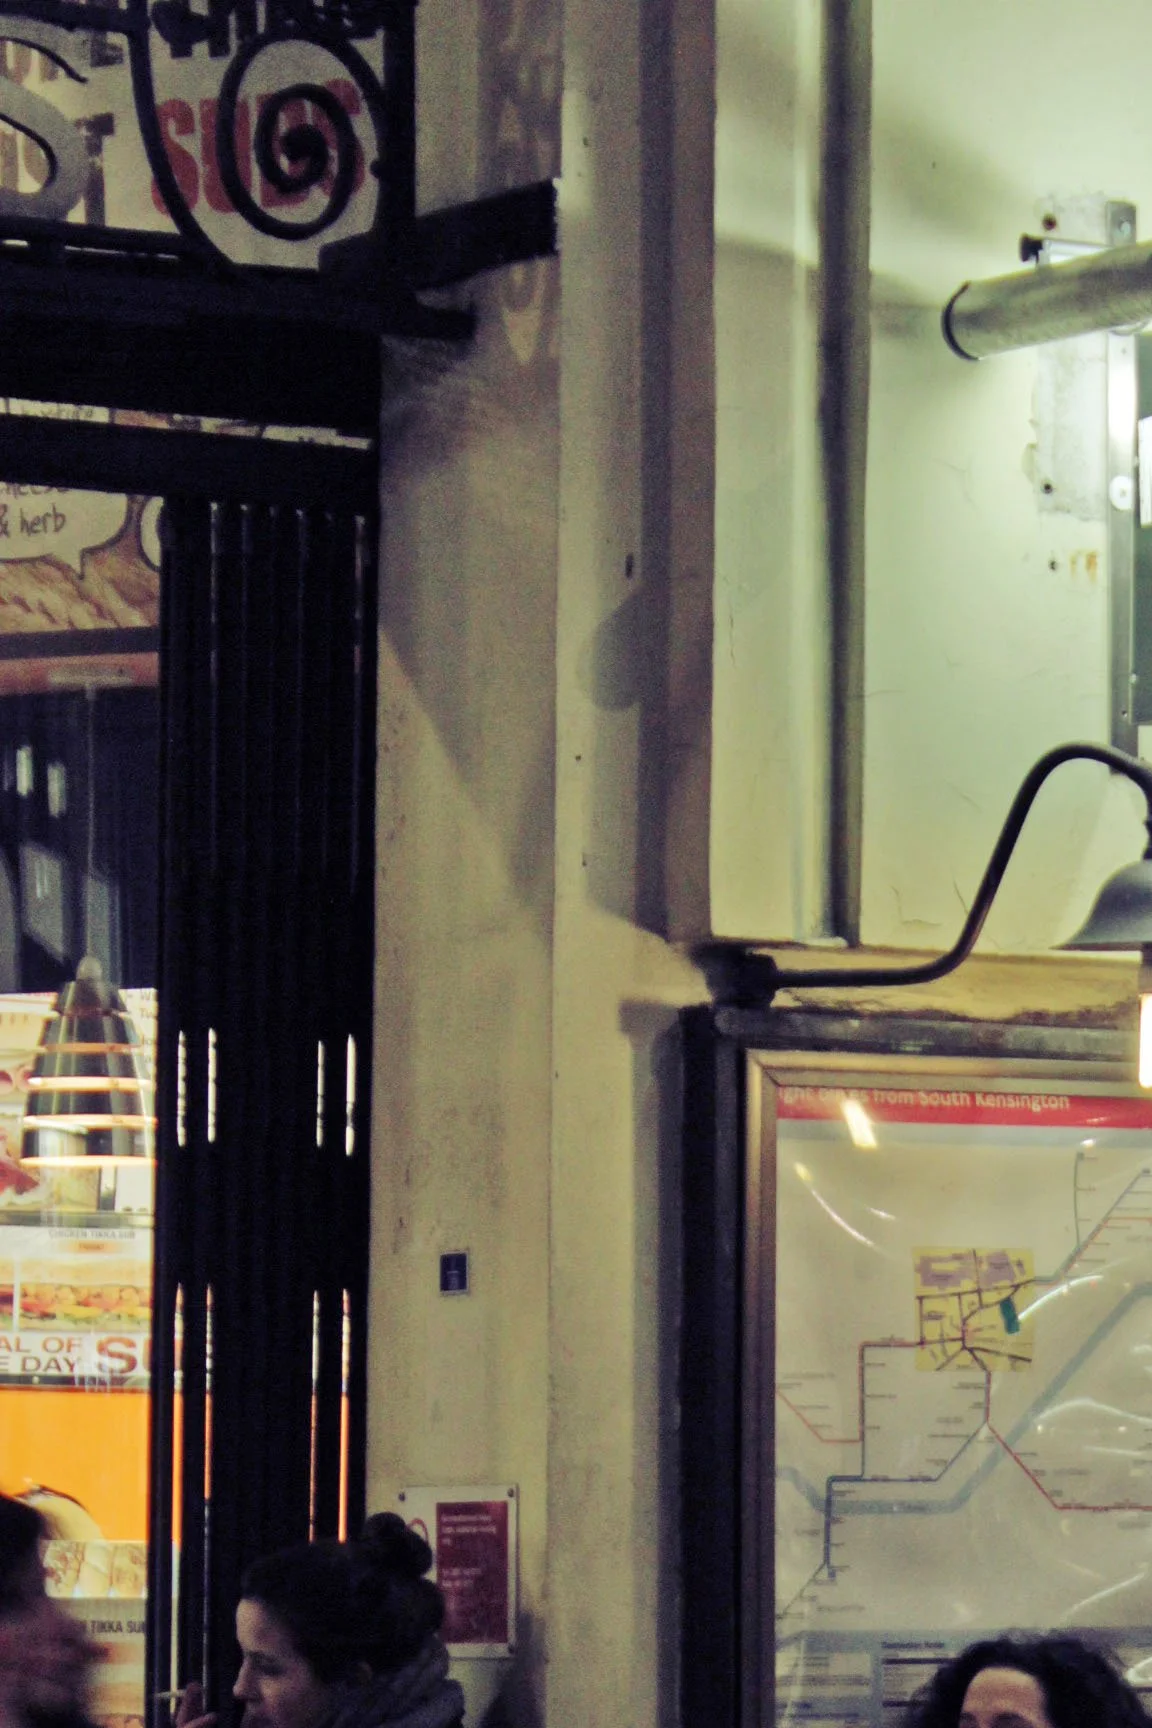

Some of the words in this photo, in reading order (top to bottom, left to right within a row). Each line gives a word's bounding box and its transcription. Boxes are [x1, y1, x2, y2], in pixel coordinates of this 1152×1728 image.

[20, 503, 66, 536] herb
[918, 1091, 971, 1107] South
[975, 1092, 1070, 1113] Kensington
[21, 1355, 81, 1373] DAY
